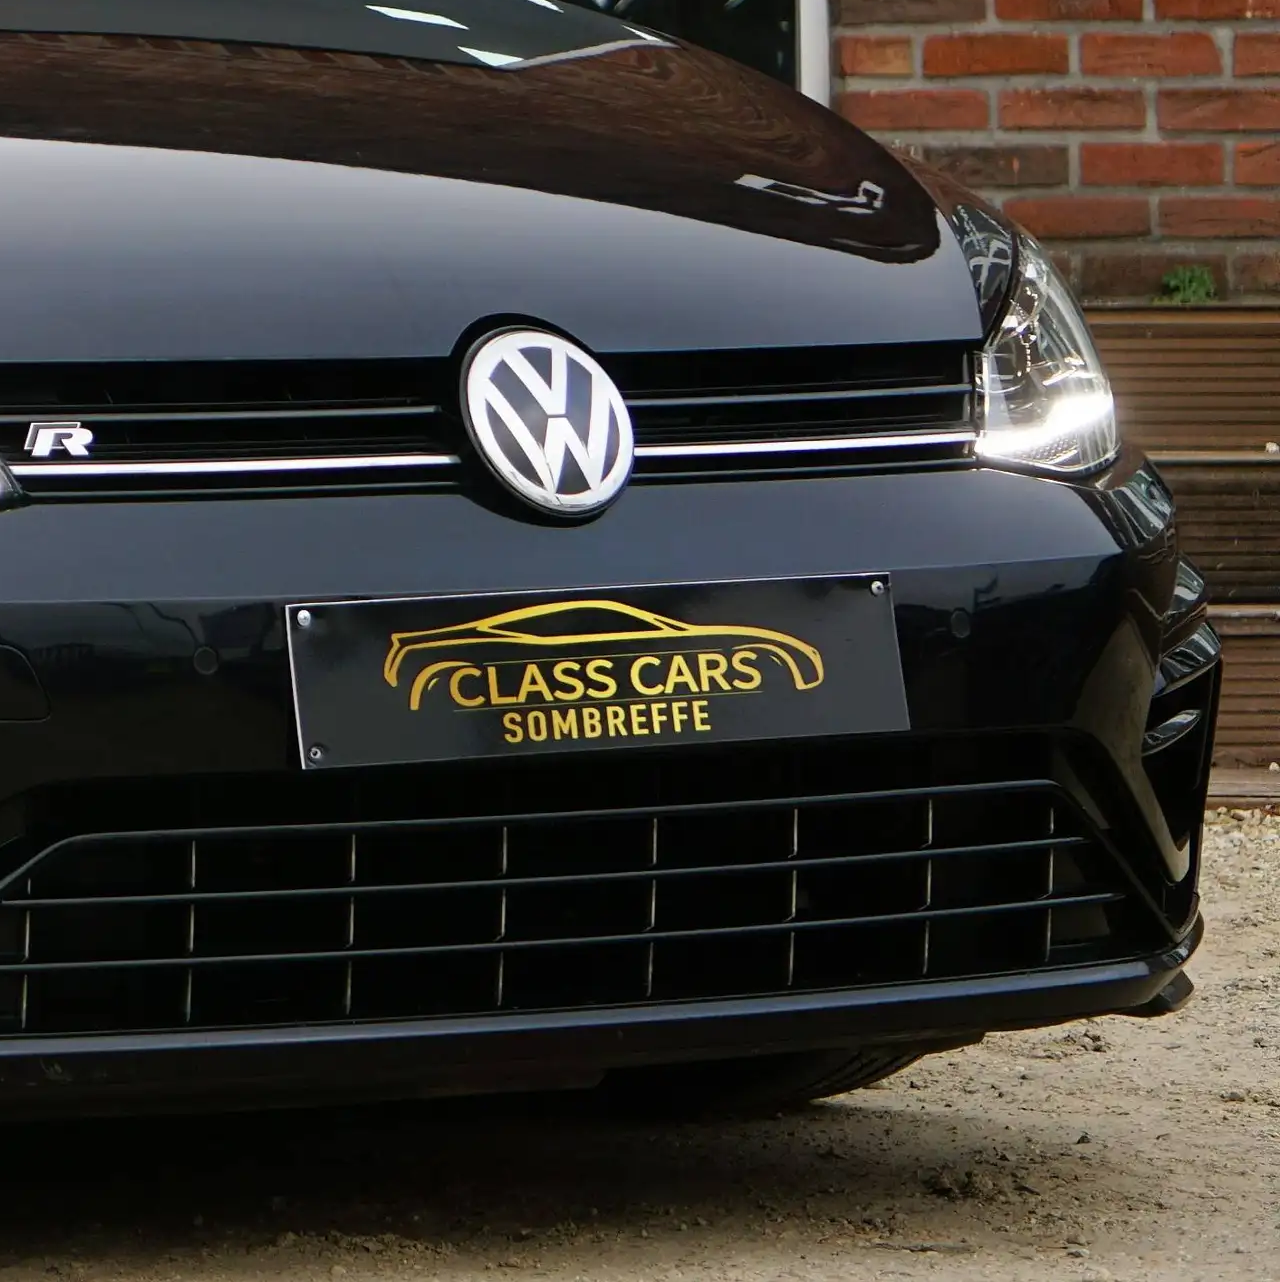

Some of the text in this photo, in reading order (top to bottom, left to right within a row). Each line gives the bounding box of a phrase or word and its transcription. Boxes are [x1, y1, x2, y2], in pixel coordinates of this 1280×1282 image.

[24, 422, 93, 456] R
[467, 330, 634, 512] VW
[449, 650, 763, 707] CLASS CARS
[503, 700, 712, 744] SOMBREFFE
